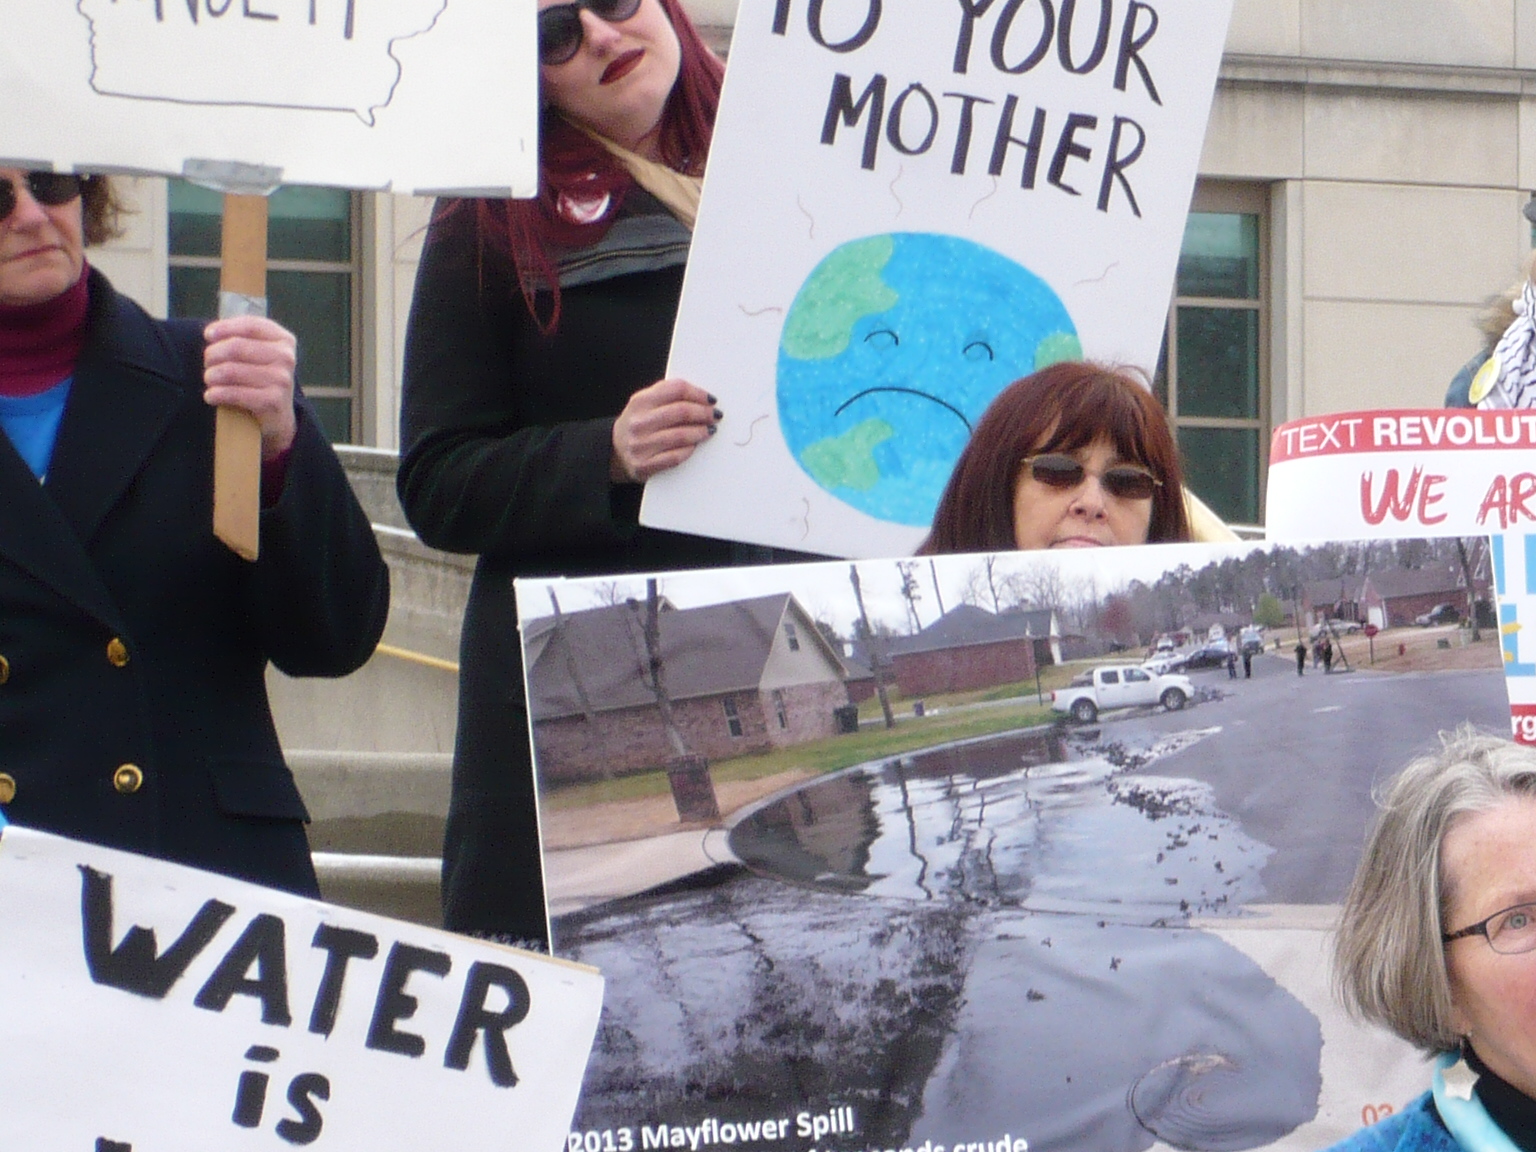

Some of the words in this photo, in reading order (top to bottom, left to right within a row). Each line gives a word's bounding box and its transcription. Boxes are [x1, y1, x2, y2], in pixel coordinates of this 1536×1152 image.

[952, 0, 1163, 106] YOUR
[820, 73, 1146, 219] MOTHER
[1281, 418, 1363, 455] TEXT
[1360, 464, 1448, 525] WE
[76, 863, 532, 1089] WATER
[231, 1044, 332, 1146] is
[641, 1116, 790, 1152] Mayflower
[796, 1106, 855, 1141] Spill
